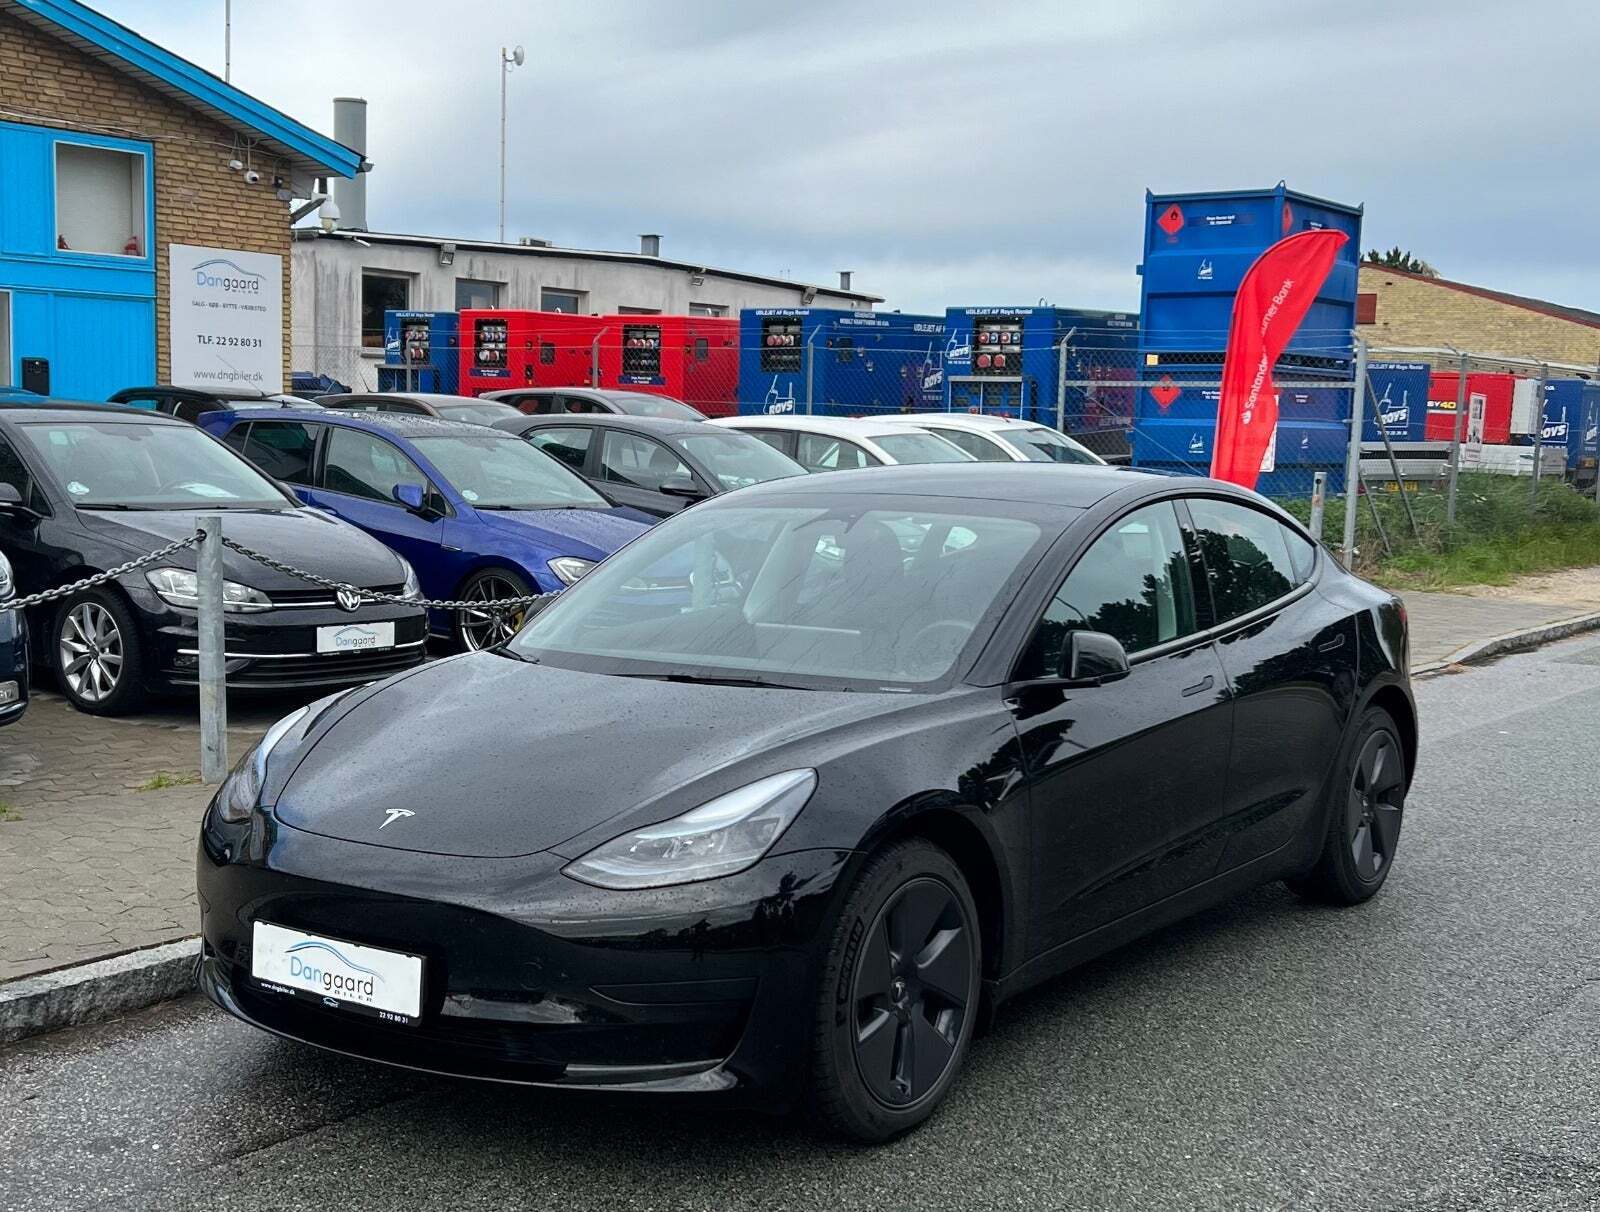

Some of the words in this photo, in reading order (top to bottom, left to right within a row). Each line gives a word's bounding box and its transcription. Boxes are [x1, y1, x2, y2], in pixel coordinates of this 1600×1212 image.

[197, 272, 259, 291] Dangaard
[1272, 279, 1295, 305] Bank
[197, 335, 215, 345] TLF.
[216, 336, 227, 346] 22
[228, 337, 239, 346] 92
[240, 338, 251, 347] 80
[252, 338, 262, 348] 31
[949, 346, 969, 357] ROYS
[193, 369, 264, 383] www.dngbiler.dk
[923, 370, 943, 389] ROYS
[768, 400, 793, 415] ROYS
[335, 635, 376, 648] Dangaard
[290, 956, 374, 996] Dangaard
